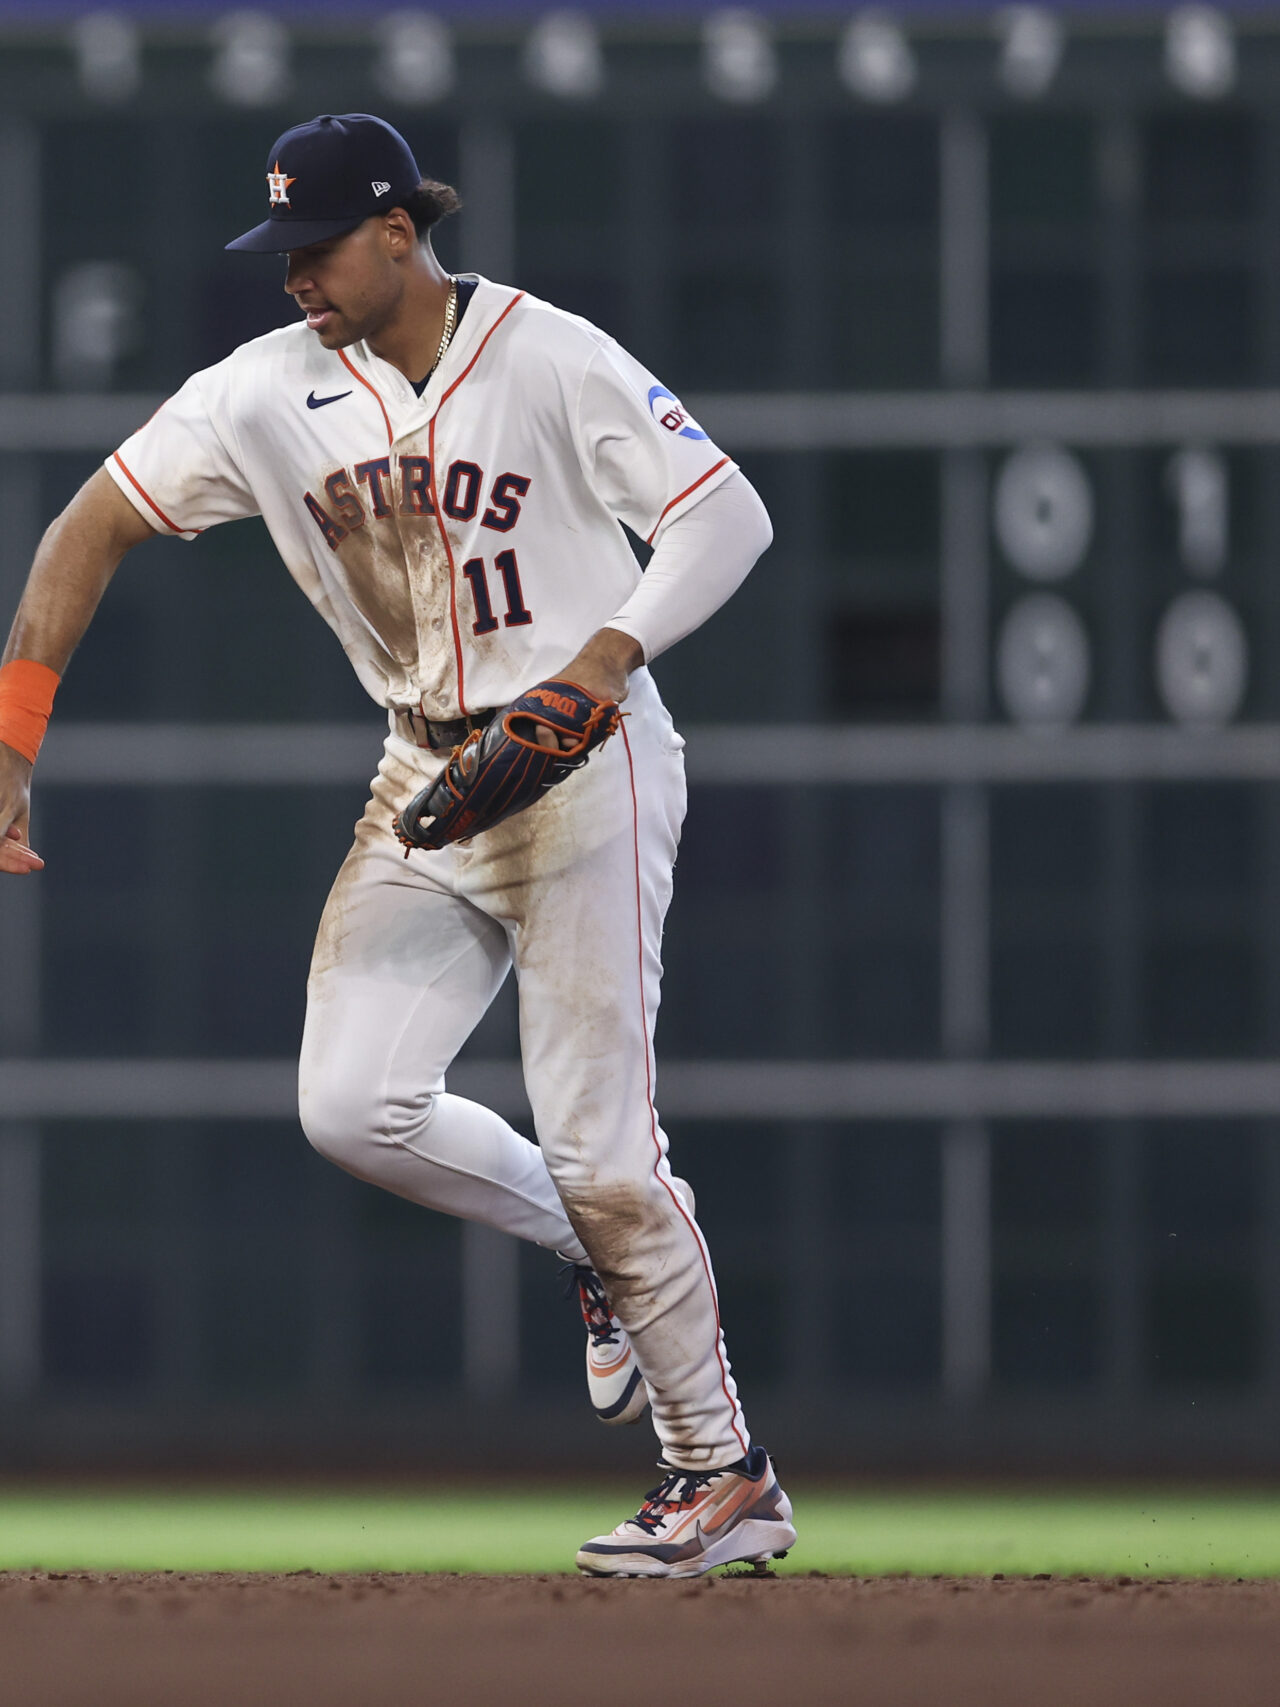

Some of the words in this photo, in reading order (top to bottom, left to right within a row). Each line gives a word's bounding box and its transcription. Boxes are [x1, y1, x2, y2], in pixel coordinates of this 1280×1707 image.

[267, 172, 290, 204] H
[303, 455, 532, 552] ASTROS
[996, 444, 1093, 582] 0
[463, 548, 533, 637] 11
